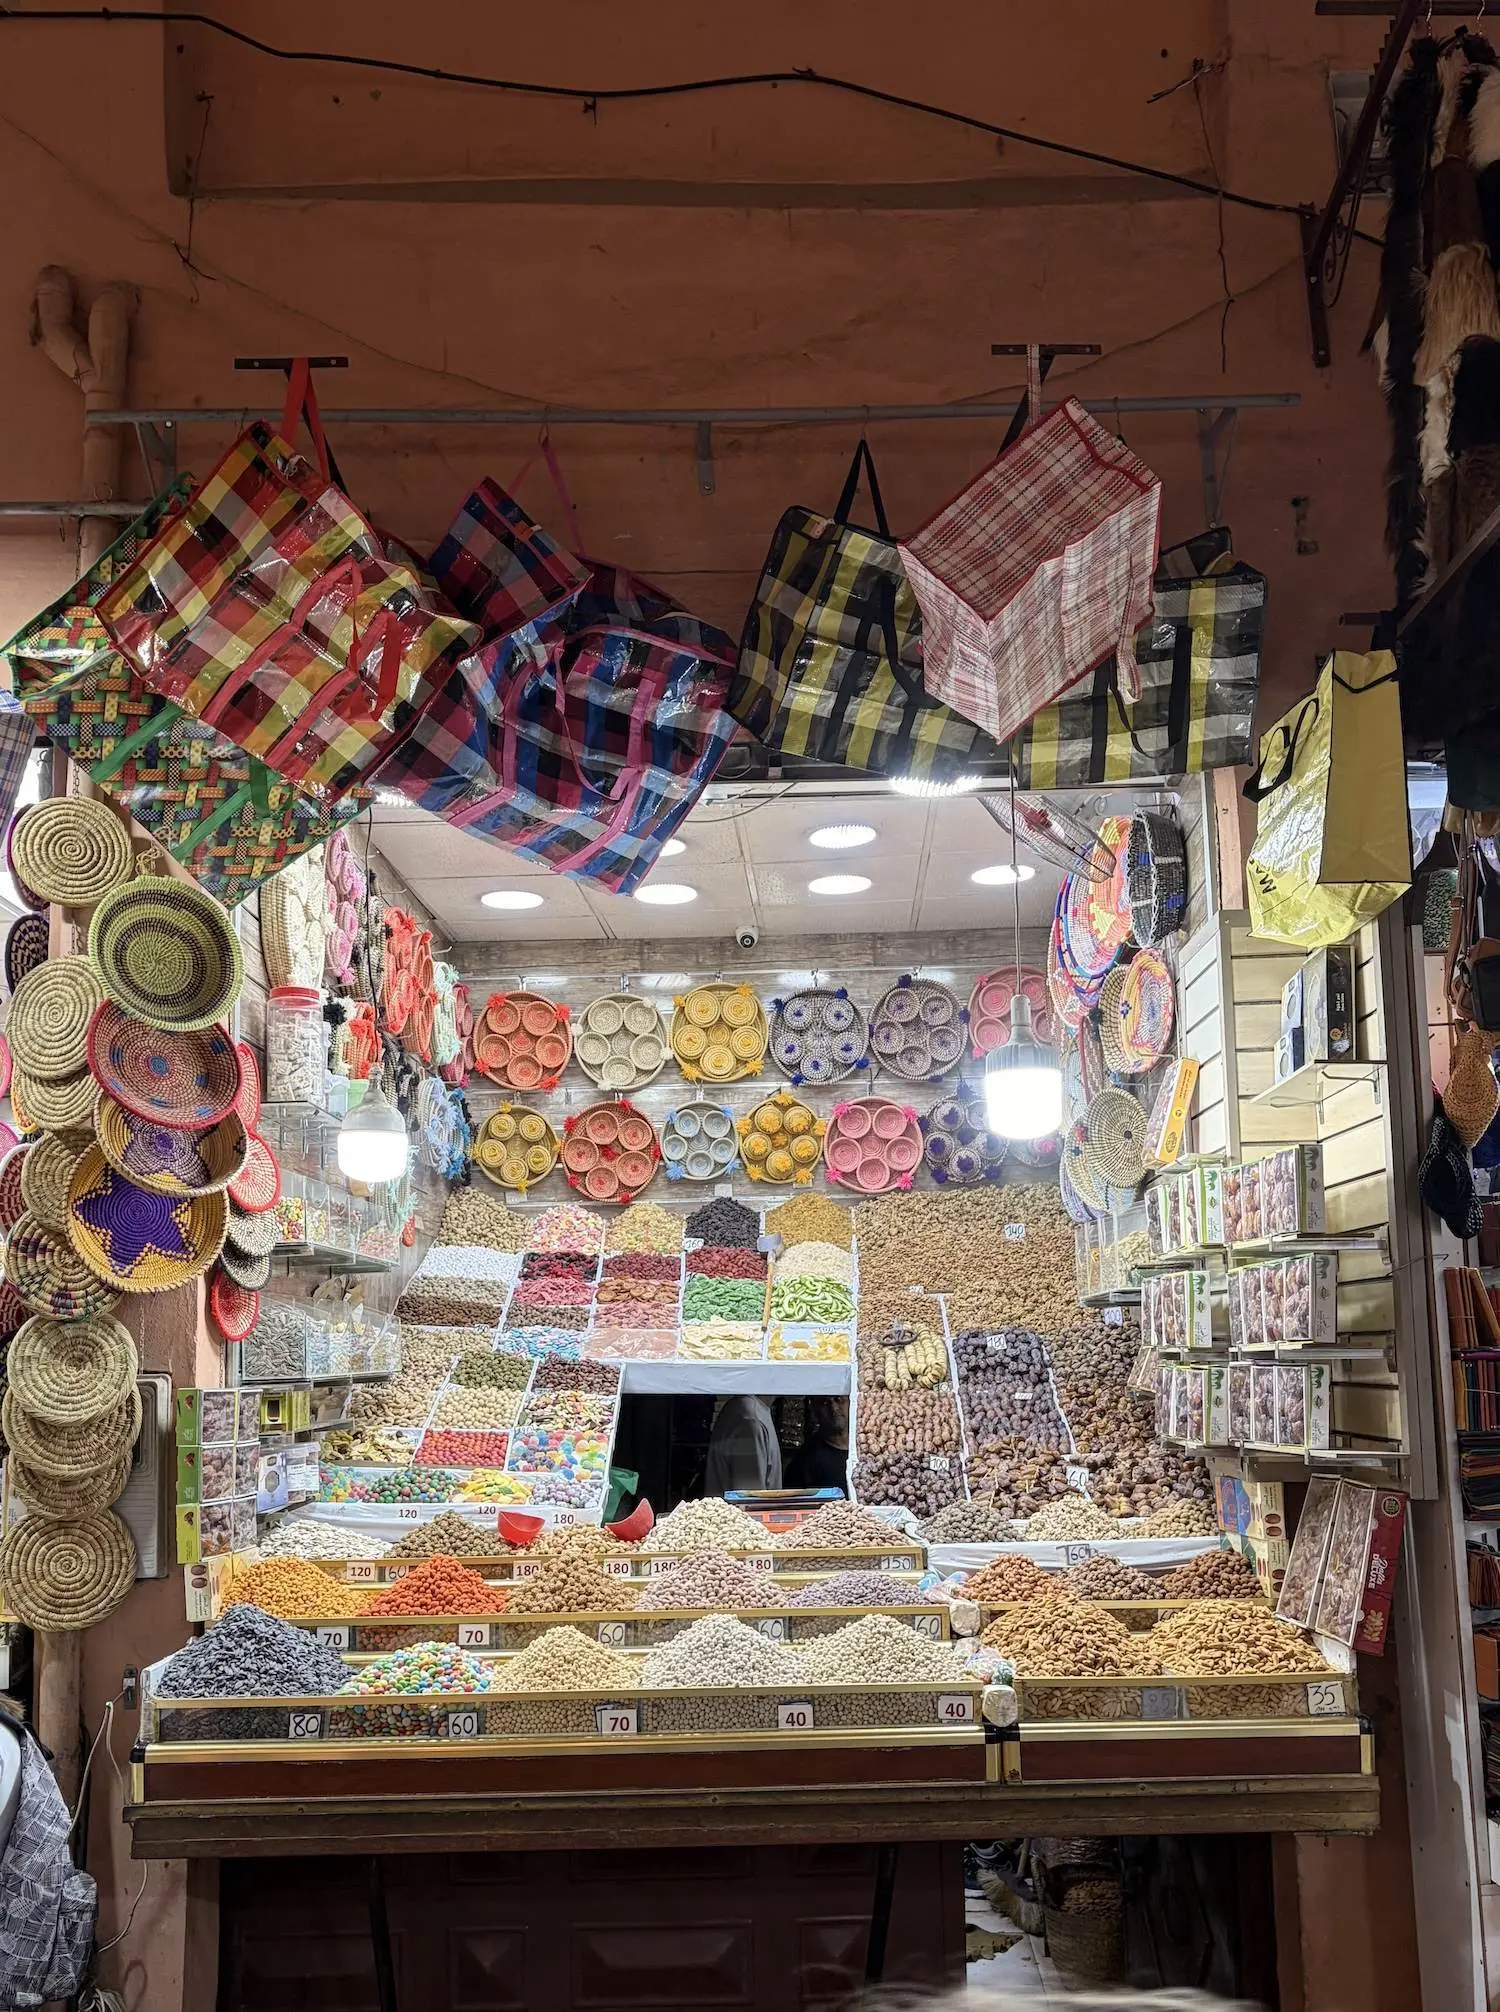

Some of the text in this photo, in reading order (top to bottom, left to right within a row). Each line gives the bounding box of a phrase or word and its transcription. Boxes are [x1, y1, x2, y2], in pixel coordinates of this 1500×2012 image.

[399, 1509, 418, 1519] 120
[477, 1506, 496, 1515] 120
[553, 1514, 575, 1525] 180
[606, 1563, 629, 1574] 180
[882, 1557, 912, 1570] 150
[350, 1567, 371, 1577] 120
[516, 1565, 539, 1577] 180
[1368, 1553, 1380, 1589] DELUXE
[760, 1620, 783, 1638] 60
[916, 1616, 940, 1636] 60
[324, 1633, 343, 1646] 70
[465, 1630, 484, 1643] 70
[600, 1623, 624, 1644] 60
[1309, 1683, 1339, 1706] 35
[945, 1703, 966, 1717] 40
[292, 1714, 319, 1737] 80
[451, 1715, 474, 1735] 60
[609, 1717, 630, 1731] 70
[785, 1712, 807, 1727] 40
